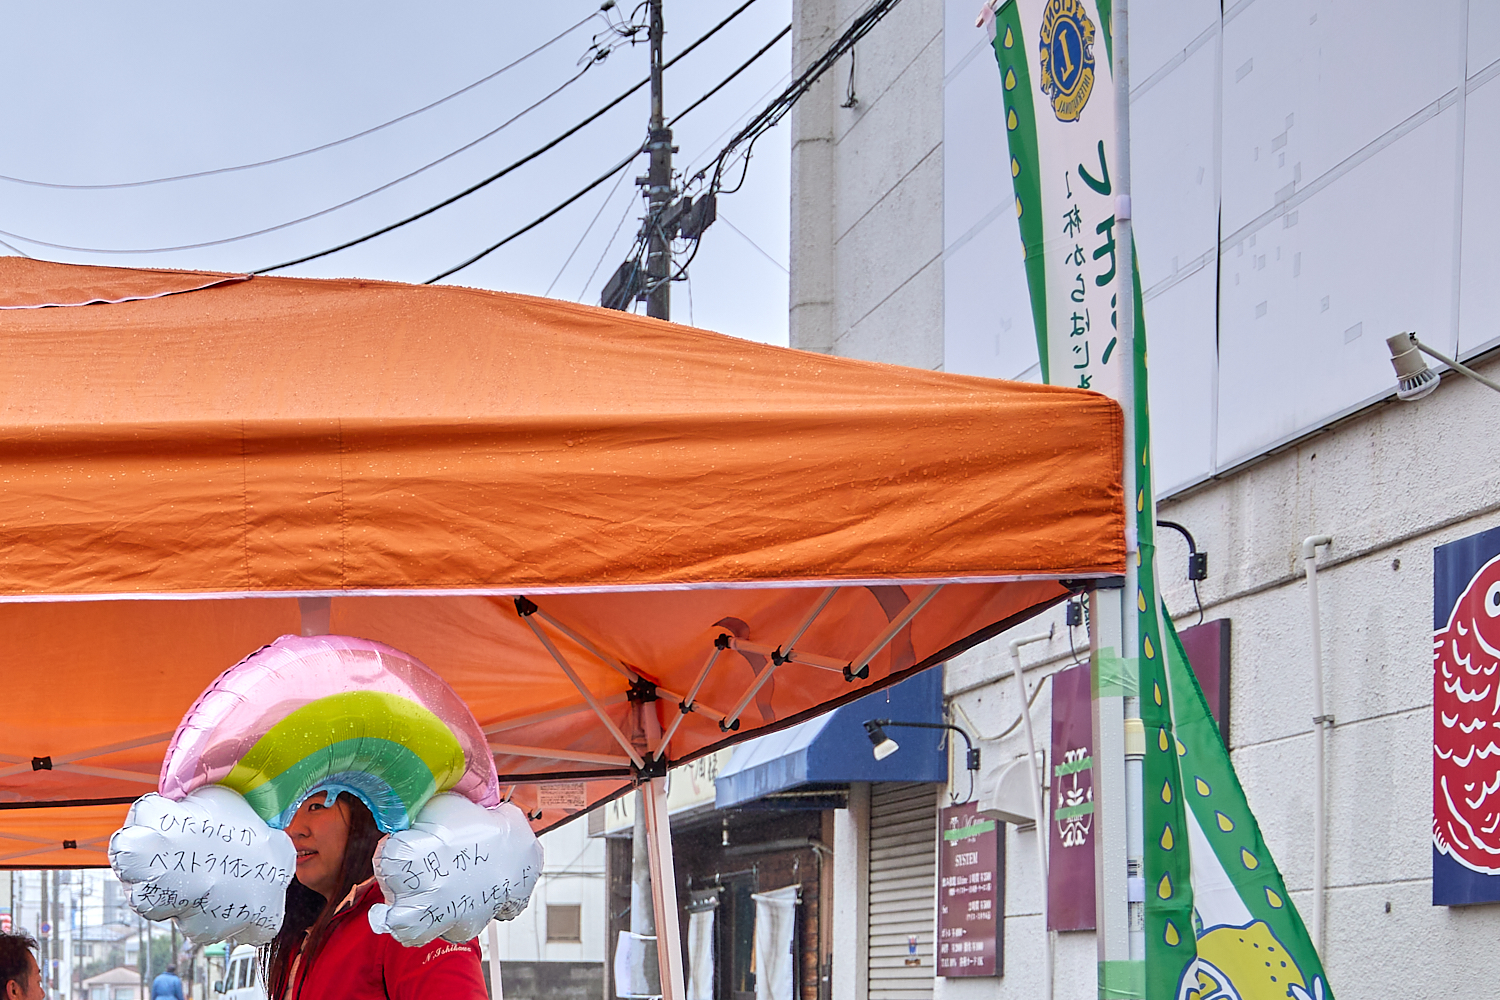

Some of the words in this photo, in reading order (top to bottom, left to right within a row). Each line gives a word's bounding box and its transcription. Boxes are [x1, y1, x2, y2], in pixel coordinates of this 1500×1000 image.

[160, 813, 257, 846] ひたちなか
